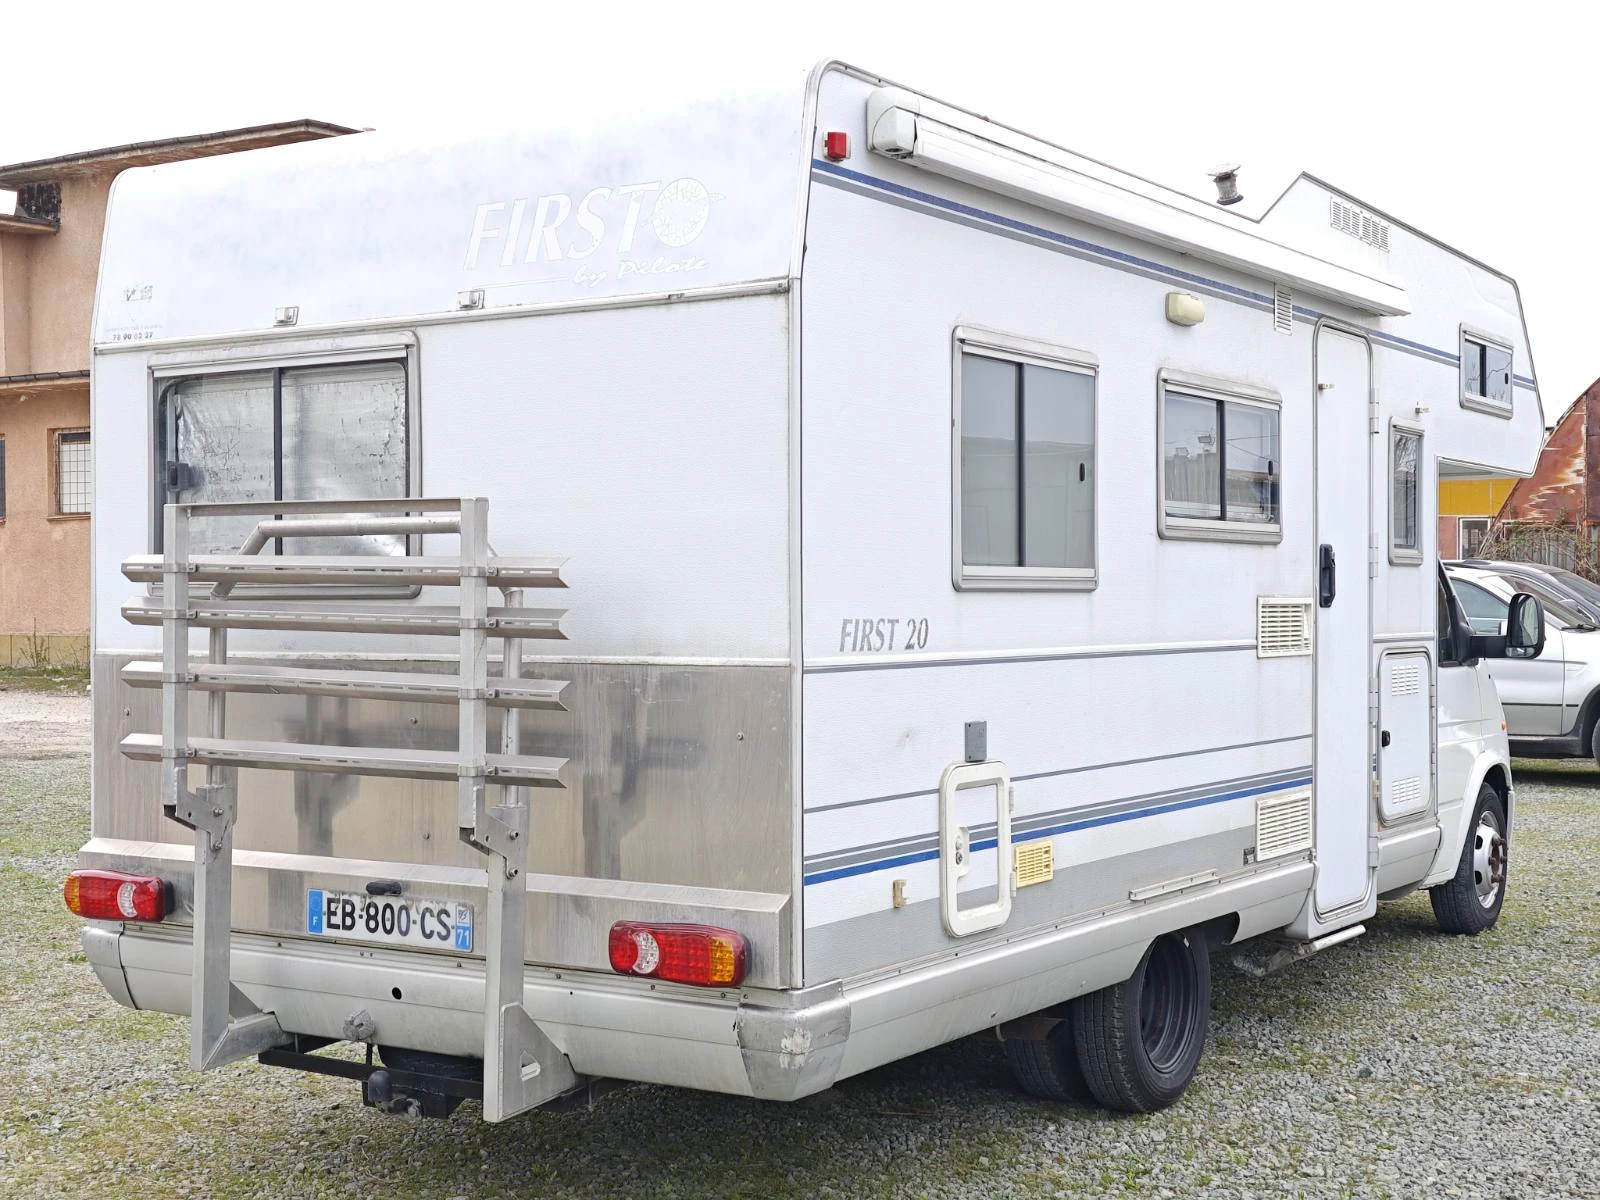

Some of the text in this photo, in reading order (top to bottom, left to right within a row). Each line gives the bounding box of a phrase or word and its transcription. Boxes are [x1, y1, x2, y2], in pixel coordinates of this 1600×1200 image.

[463, 180, 661, 270] FIRST
[574, 265, 607, 288] by
[840, 617, 929, 652] FIRST 20
[312, 916, 318, 926] F
[326, 897, 451, 942] EB-800-CS
[457, 928, 470, 946] 71
